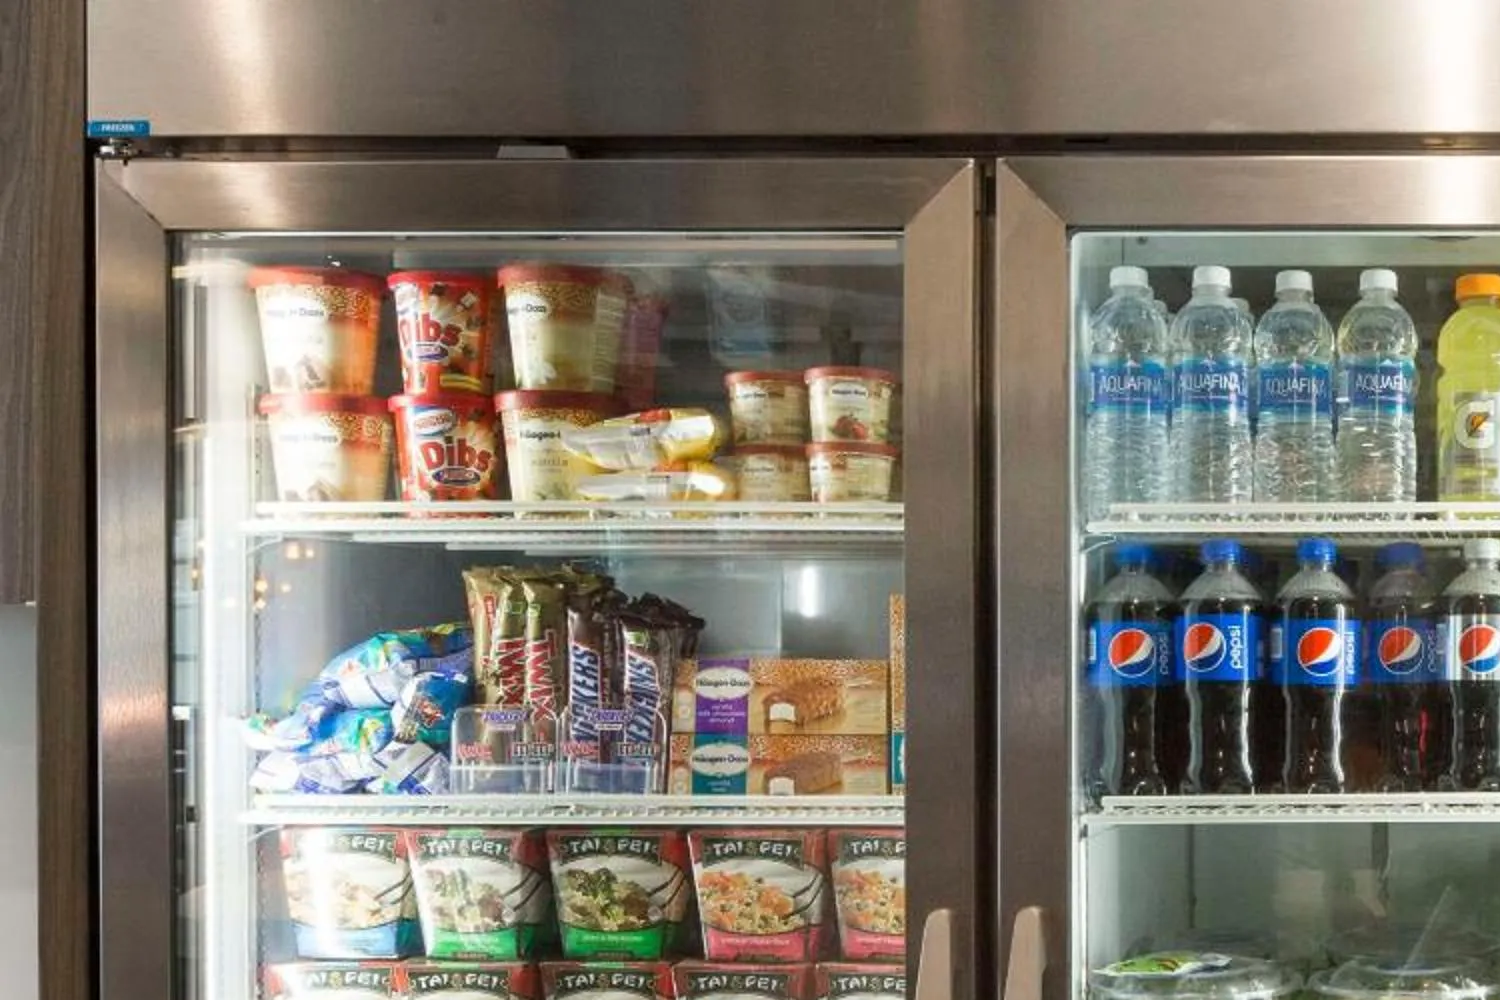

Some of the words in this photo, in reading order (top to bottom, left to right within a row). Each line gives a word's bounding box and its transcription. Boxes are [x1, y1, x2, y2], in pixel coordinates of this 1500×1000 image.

[419, 441, 493, 472] Dibs
[1229, 625, 1242, 669] pepsi
[569, 839, 602, 853] TAI
[617, 839, 650, 854] PEI
[713, 842, 744, 856] TAI
[760, 841, 793, 856] PEI
[419, 974, 448, 989] TAI
[465, 973, 498, 988] PEI
[564, 974, 596, 988] TAI
[612, 973, 646, 988] PEI
[698, 976, 731, 990] TAI
[745, 975, 780, 990] PEI
[883, 977, 906, 990] PE
